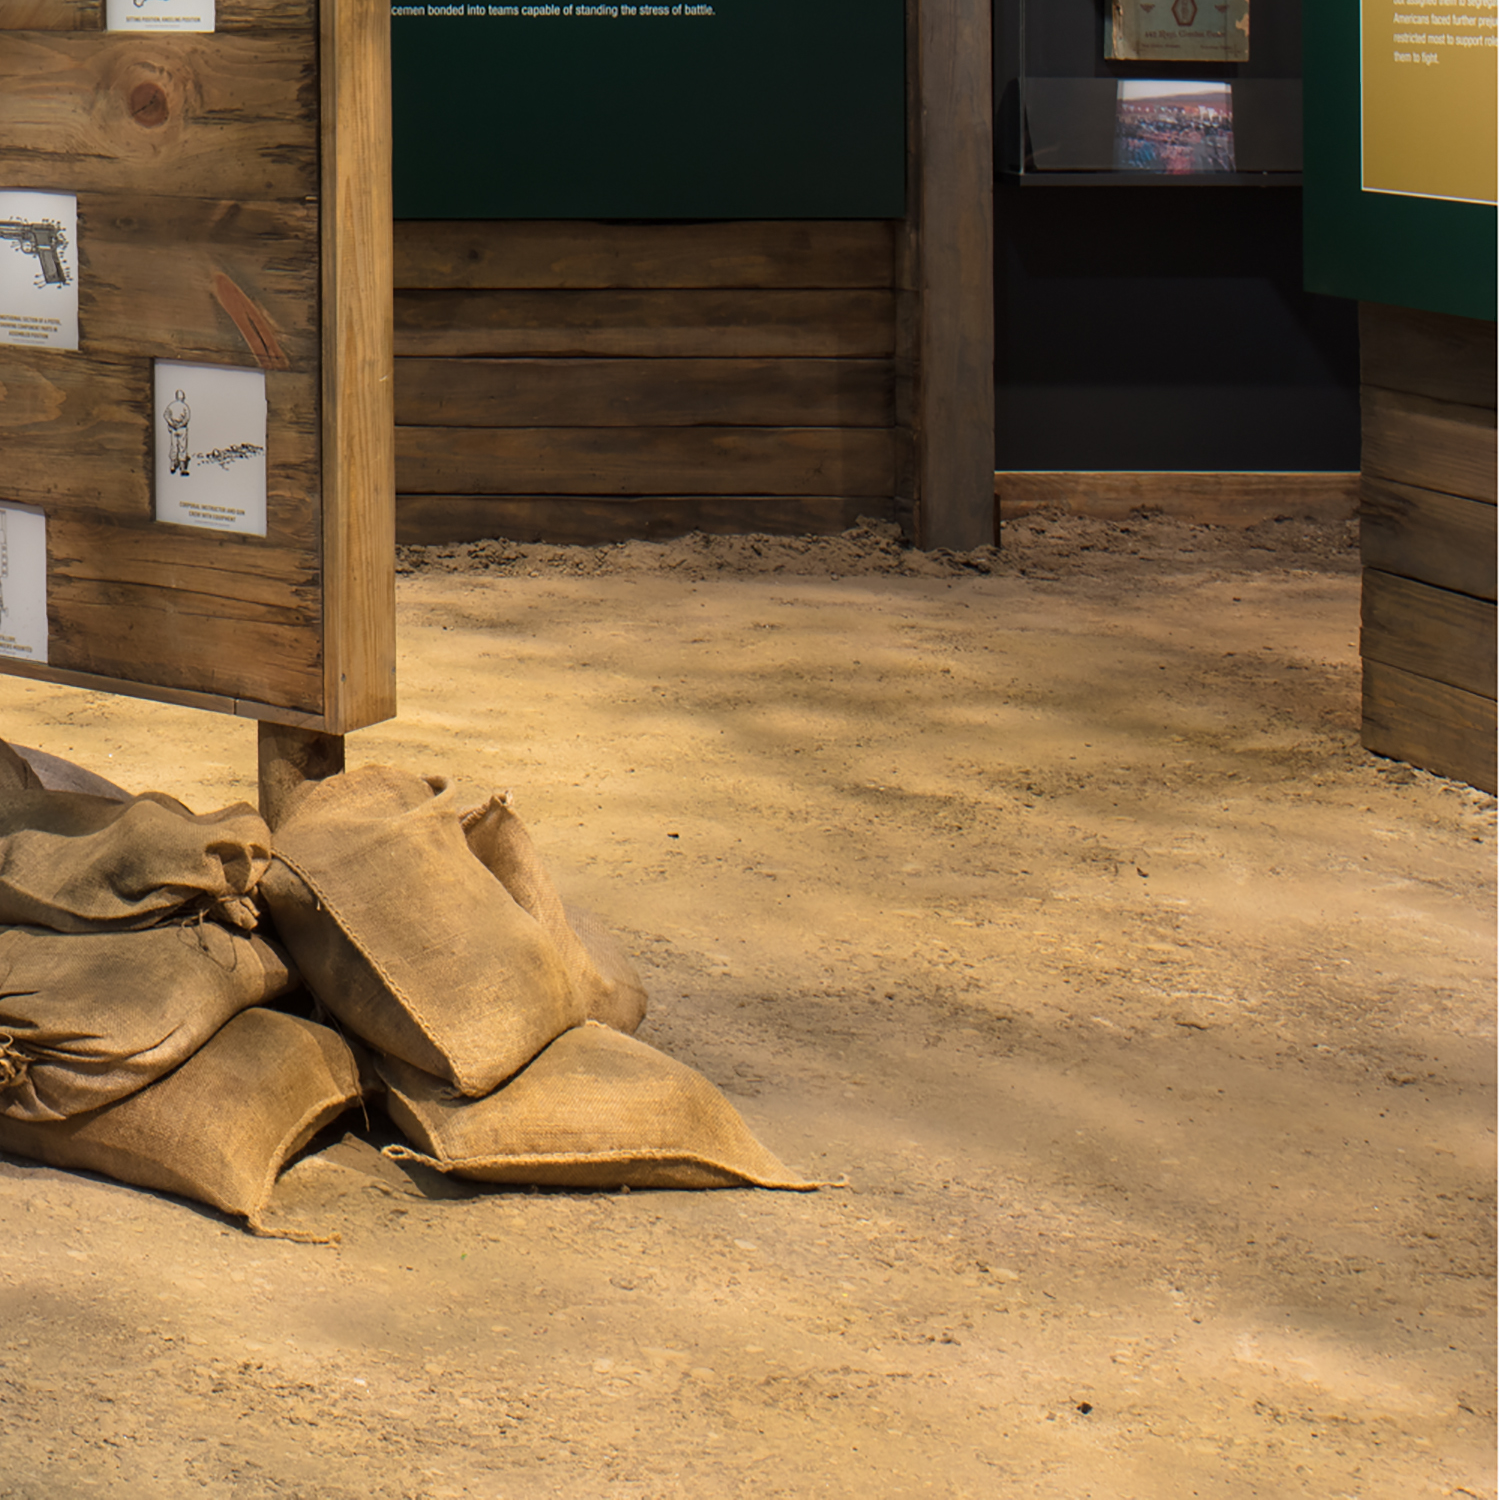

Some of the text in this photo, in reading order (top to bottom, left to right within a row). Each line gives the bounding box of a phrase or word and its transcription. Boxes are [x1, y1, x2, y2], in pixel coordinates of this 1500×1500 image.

[427, 3, 715, 18] bonded into teams capable of standing the stress of battle.
